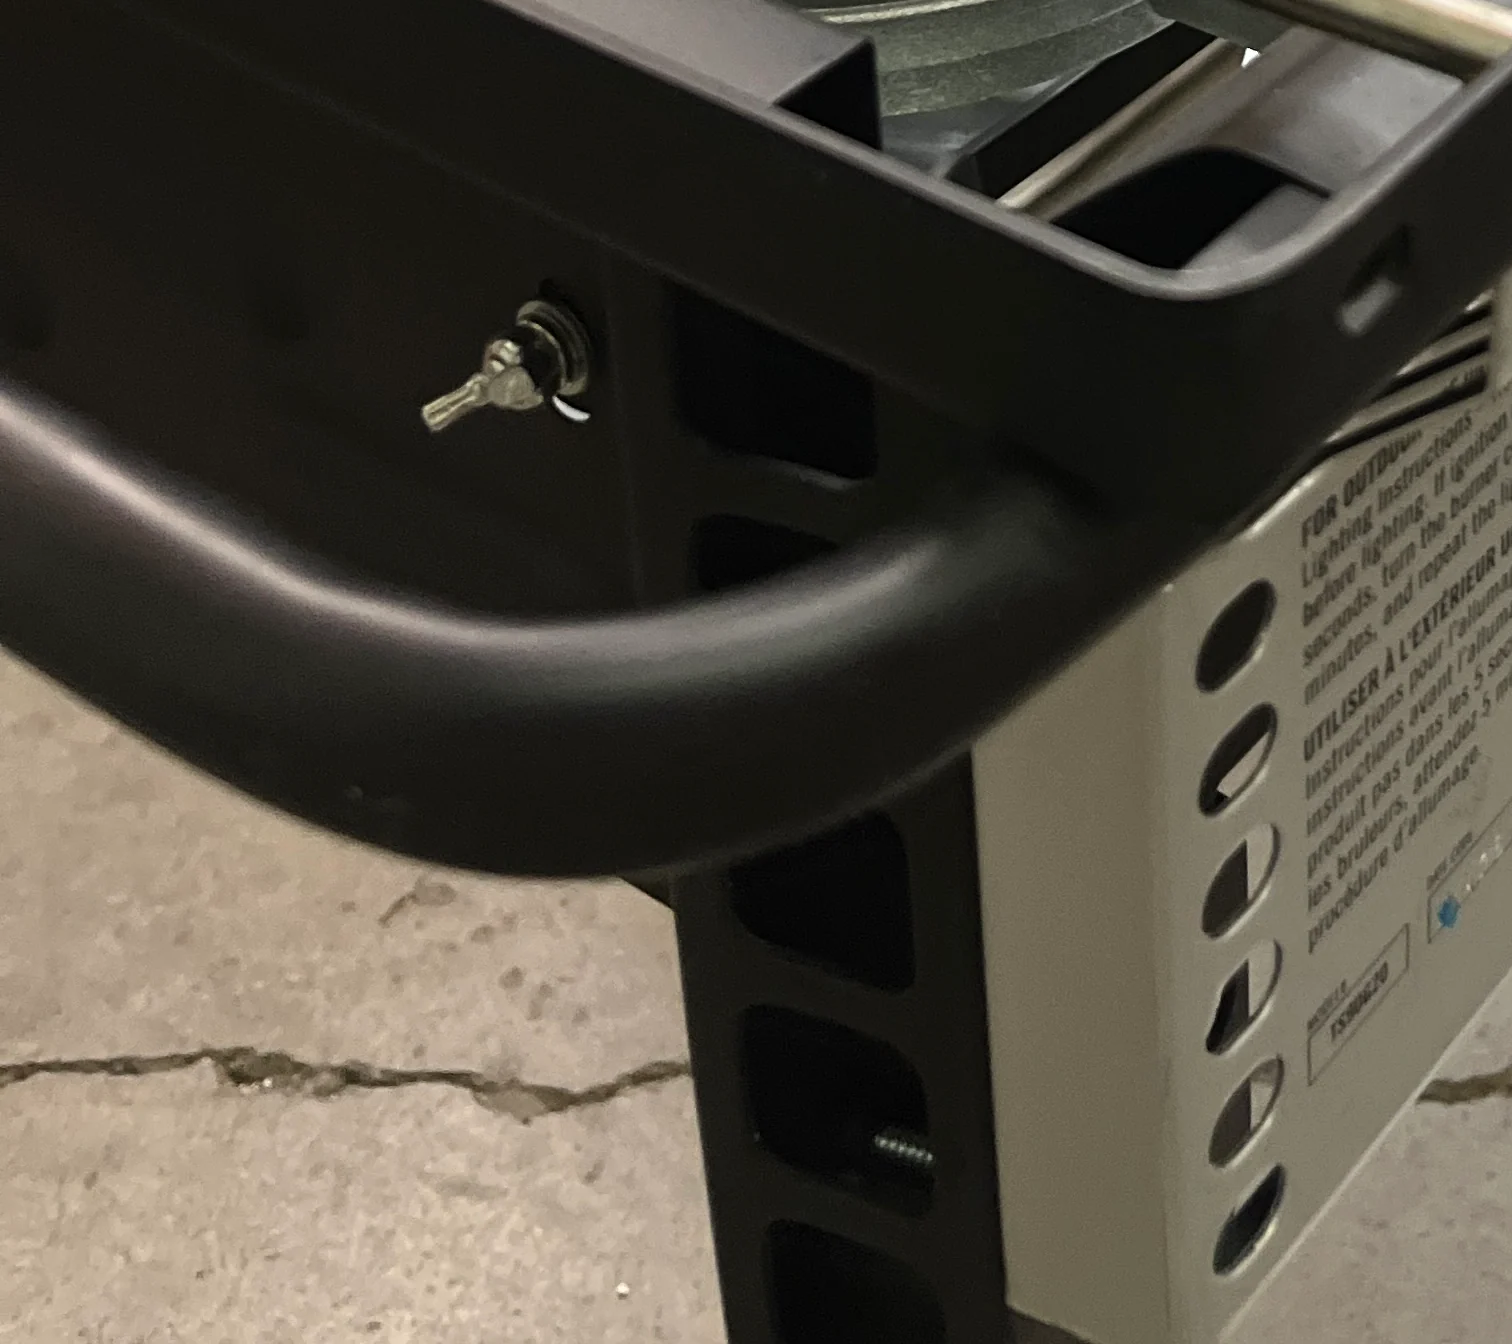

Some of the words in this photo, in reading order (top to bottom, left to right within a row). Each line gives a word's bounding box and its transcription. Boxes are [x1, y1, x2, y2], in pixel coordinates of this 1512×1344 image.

[1302, 503, 1372, 590] Lighting
[1378, 408, 1471, 513] Instructions
[1302, 488, 1336, 549] FOR
[1304, 559, 1355, 628] before
[1434, 463, 1444, 498] If
[1450, 408, 1507, 481] ignition
[1381, 538, 1415, 590] turn
[1420, 508, 1445, 550] the
[1450, 456, 1497, 520] burner
[1383, 574, 1412, 626] and
[1418, 519, 1465, 589] repeat
[1472, 494, 1496, 535] the
[1304, 662, 1379, 765] UTILISER
[1384, 641, 1394, 680] À
[1399, 542, 1495, 665] L'EXTÉRIEUR
[1306, 680, 1403, 802] Instructions
[1409, 638, 1443, 697] pour
[1306, 716, 1404, 839] instructions
[1409, 660, 1452, 729] avant
[1307, 791, 1365, 881] produit
[1372, 757, 1400, 812] pas
[1405, 710, 1443, 769] dans
[1448, 681, 1469, 721] les
[1473, 661, 1483, 693] 5
[1307, 870, 1331, 915] les
[1412, 708, 1477, 797] attendez
[1480, 688, 1491, 723] 5
[1308, 845, 1388, 957] procédure
